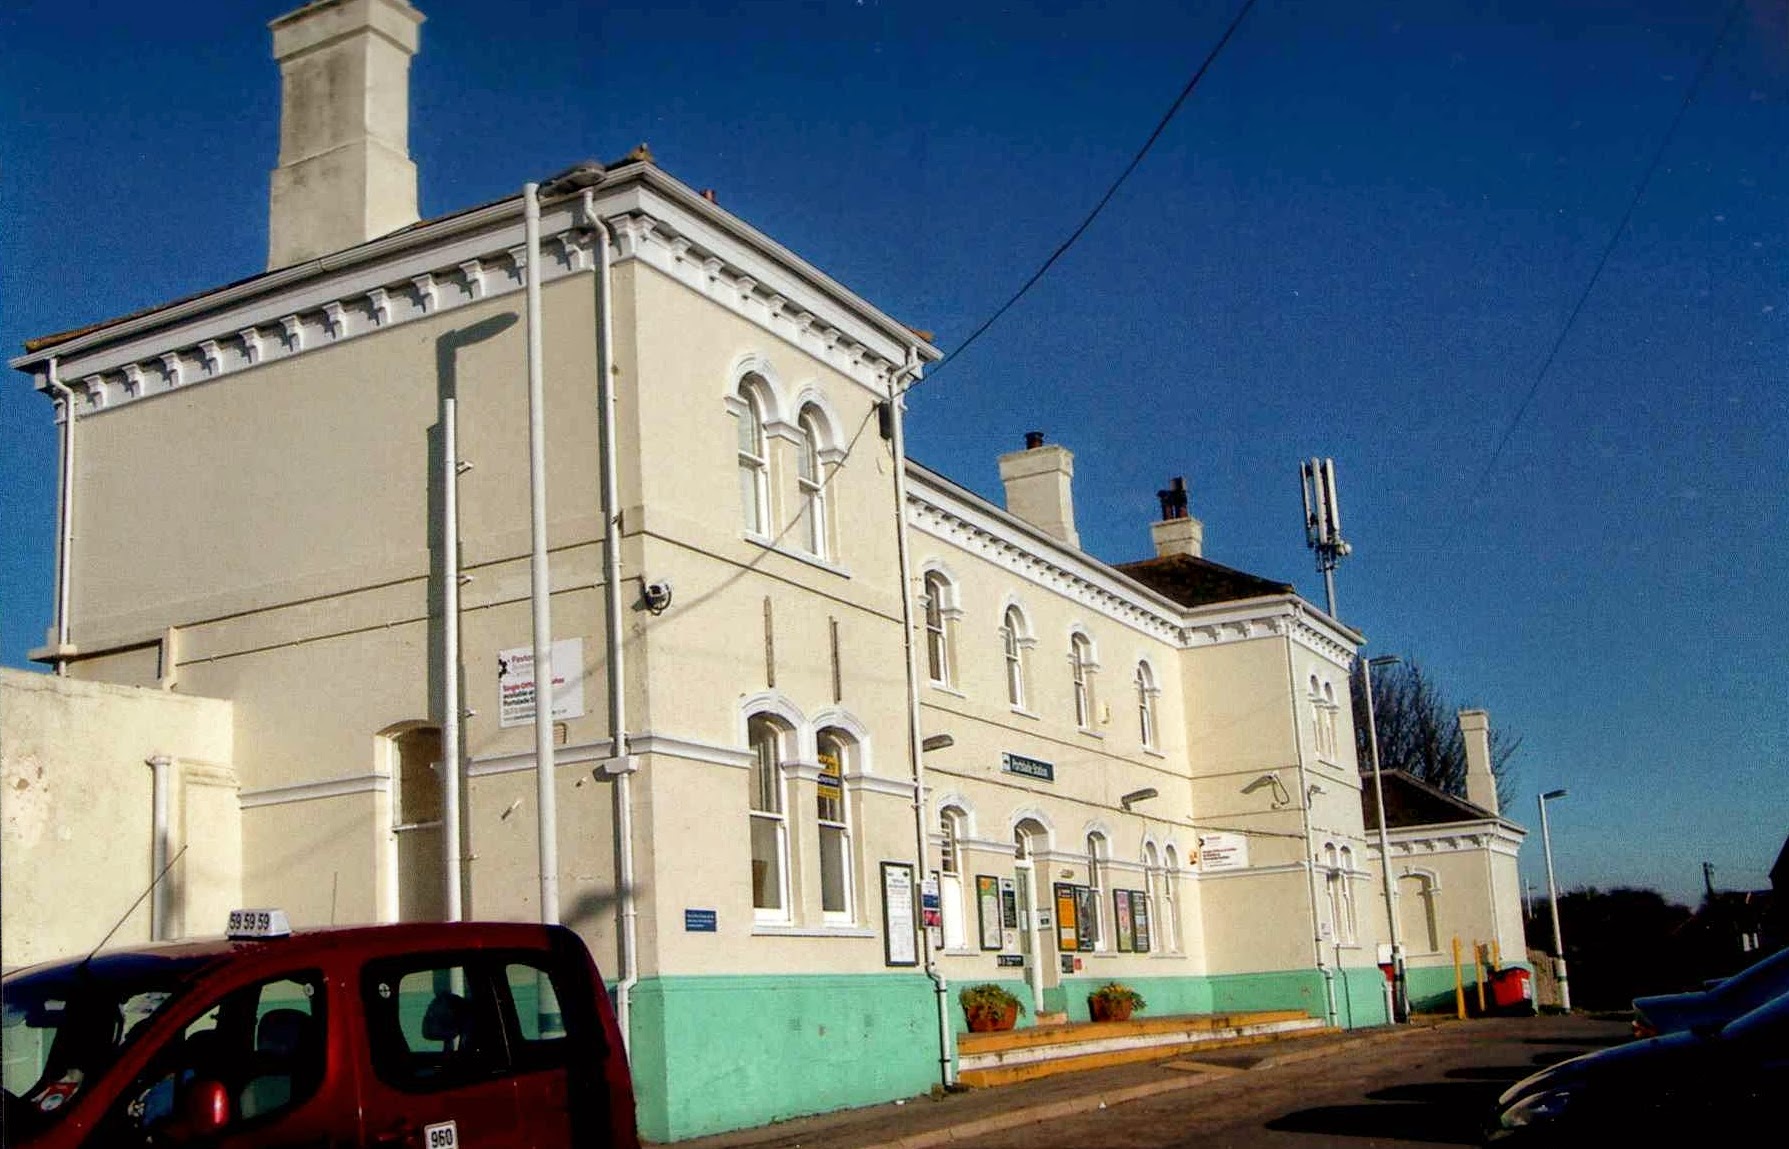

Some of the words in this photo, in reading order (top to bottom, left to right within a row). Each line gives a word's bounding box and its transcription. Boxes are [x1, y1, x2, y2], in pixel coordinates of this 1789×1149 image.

[229, 912, 242, 930] 59
[243, 912, 256, 930] 59
[257, 912, 270, 930] 59
[431, 1128, 453, 1148] 960
